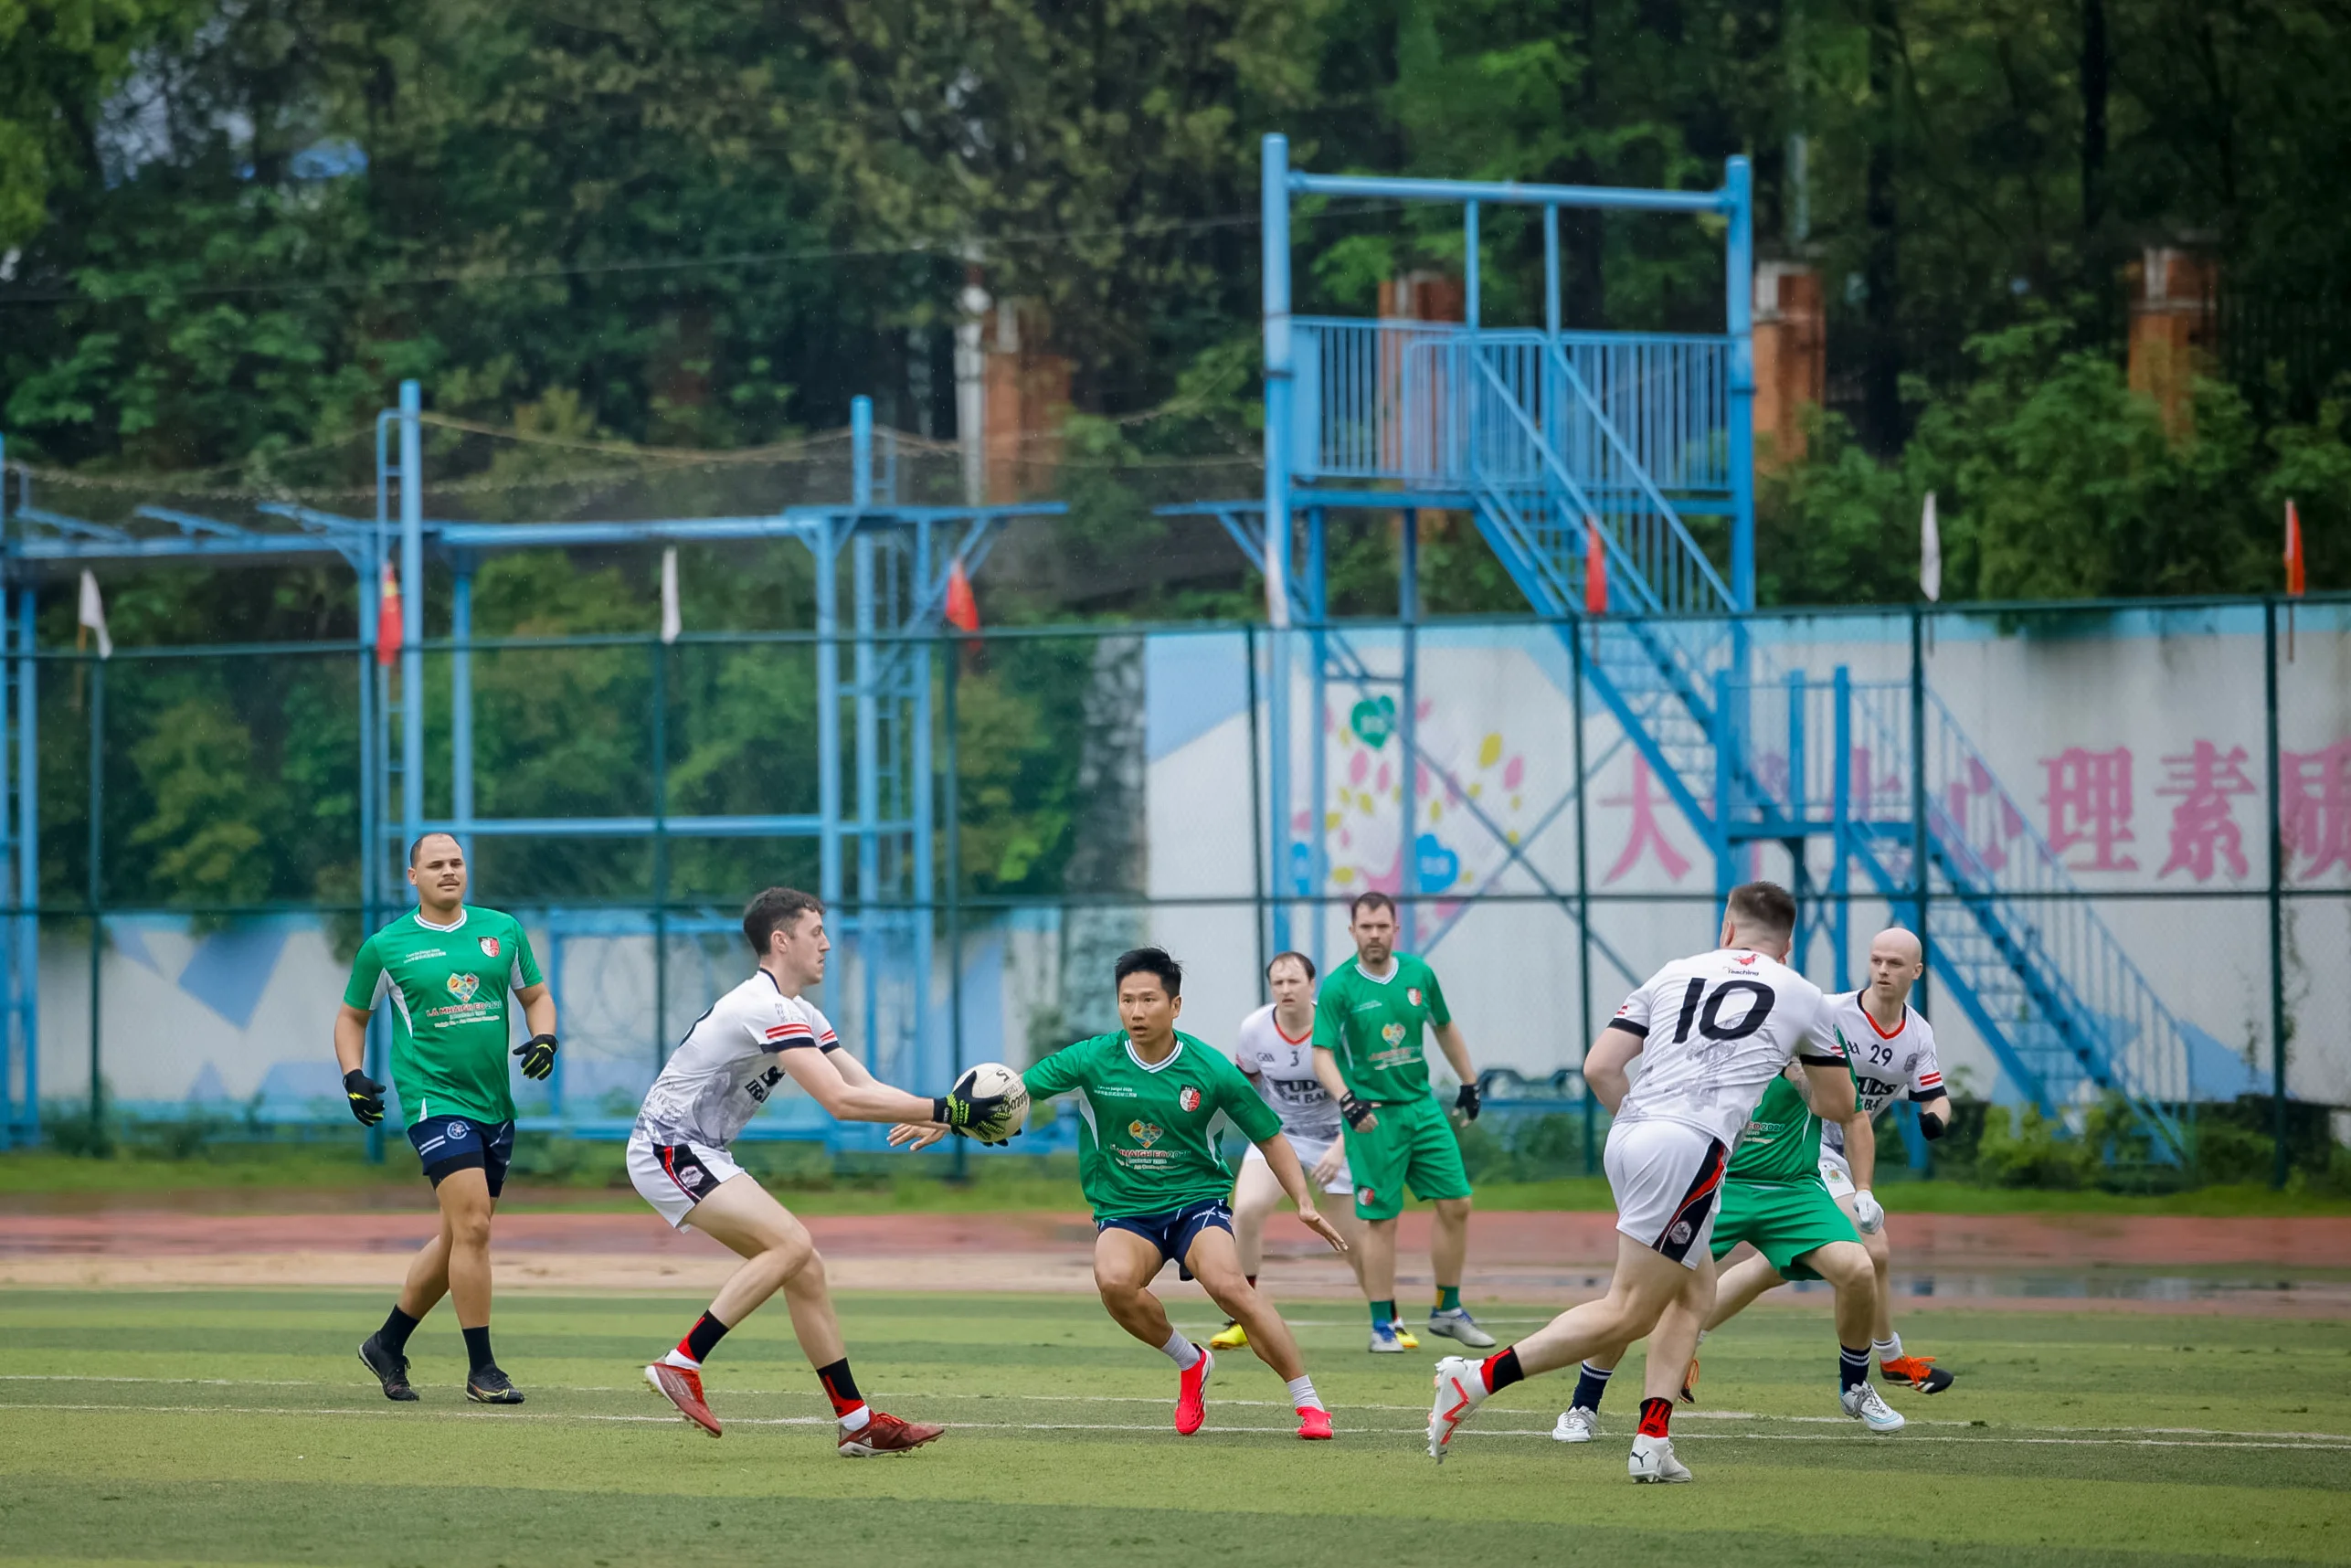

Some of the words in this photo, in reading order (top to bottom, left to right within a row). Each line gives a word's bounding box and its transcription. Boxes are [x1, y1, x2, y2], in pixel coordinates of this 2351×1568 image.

[1671, 977, 1776, 1044] 10
[1289, 1050, 1299, 1067] 3
[1868, 1044, 1893, 1067] 29
